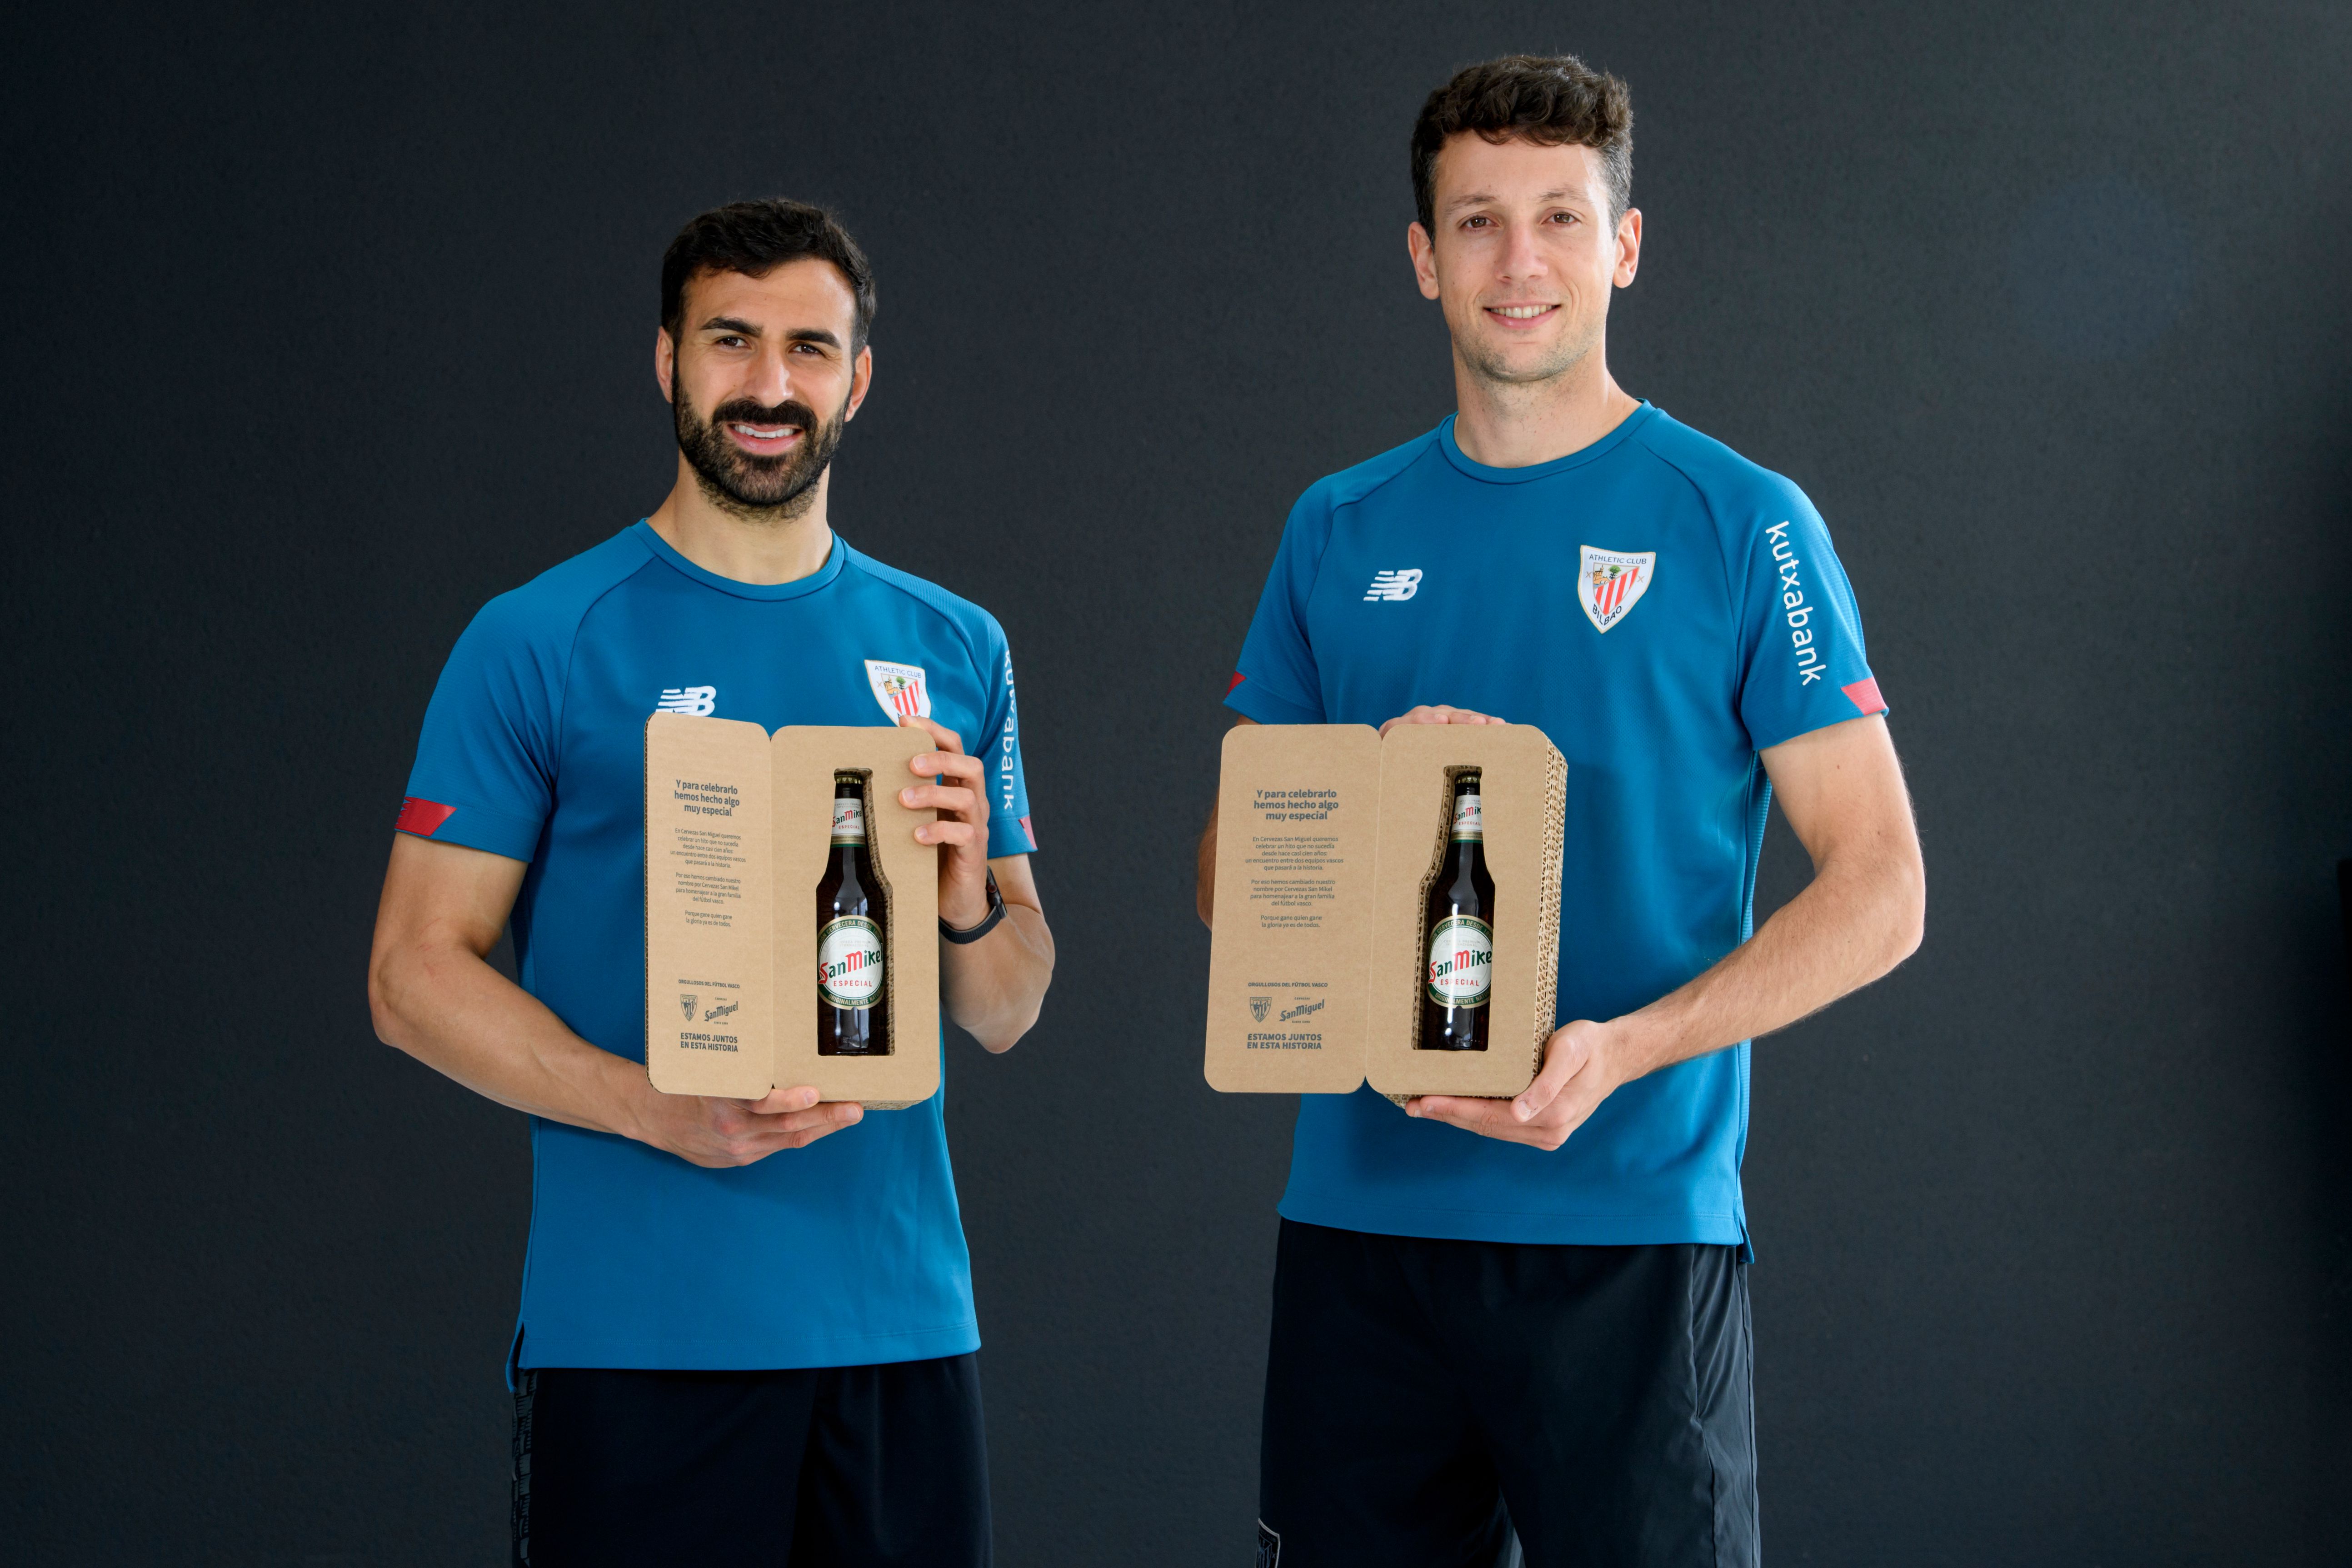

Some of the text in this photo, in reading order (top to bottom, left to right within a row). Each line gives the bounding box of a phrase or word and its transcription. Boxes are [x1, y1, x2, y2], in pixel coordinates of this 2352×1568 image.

[1589, 554, 1624, 564] ATHLETIC
[1765, 521, 1827, 686] kutxabank
[1592, 604, 1622, 626] BILBAO
[874, 665, 922, 679] ATHLETIC CLUB
[676, 779, 738, 794] Y para celebrarlo
[674, 790, 740, 807] hemos hecho algo
[1257, 789, 1337, 800] Y para celebrarlo
[684, 804, 732, 817] muy especial
[1254, 799, 1339, 811] hemos hecho algo
[1266, 811, 1328, 822] muy especial
[827, 921, 856, 934] CERVECERA
[857, 921, 873, 931] DESDE
[1437, 920, 1465, 933] CERVECERA
[1466, 921, 1483, 931] DESDE
[828, 994, 869, 1006] ORIGINALMENTE
[1435, 992, 1475, 1005] ORIGINALMENTE
[681, 1033, 738, 1043] ESTAMOS JUNTOS
[691, 1041, 706, 1049] ESTA
[708, 1043, 738, 1052] HISTORIA
